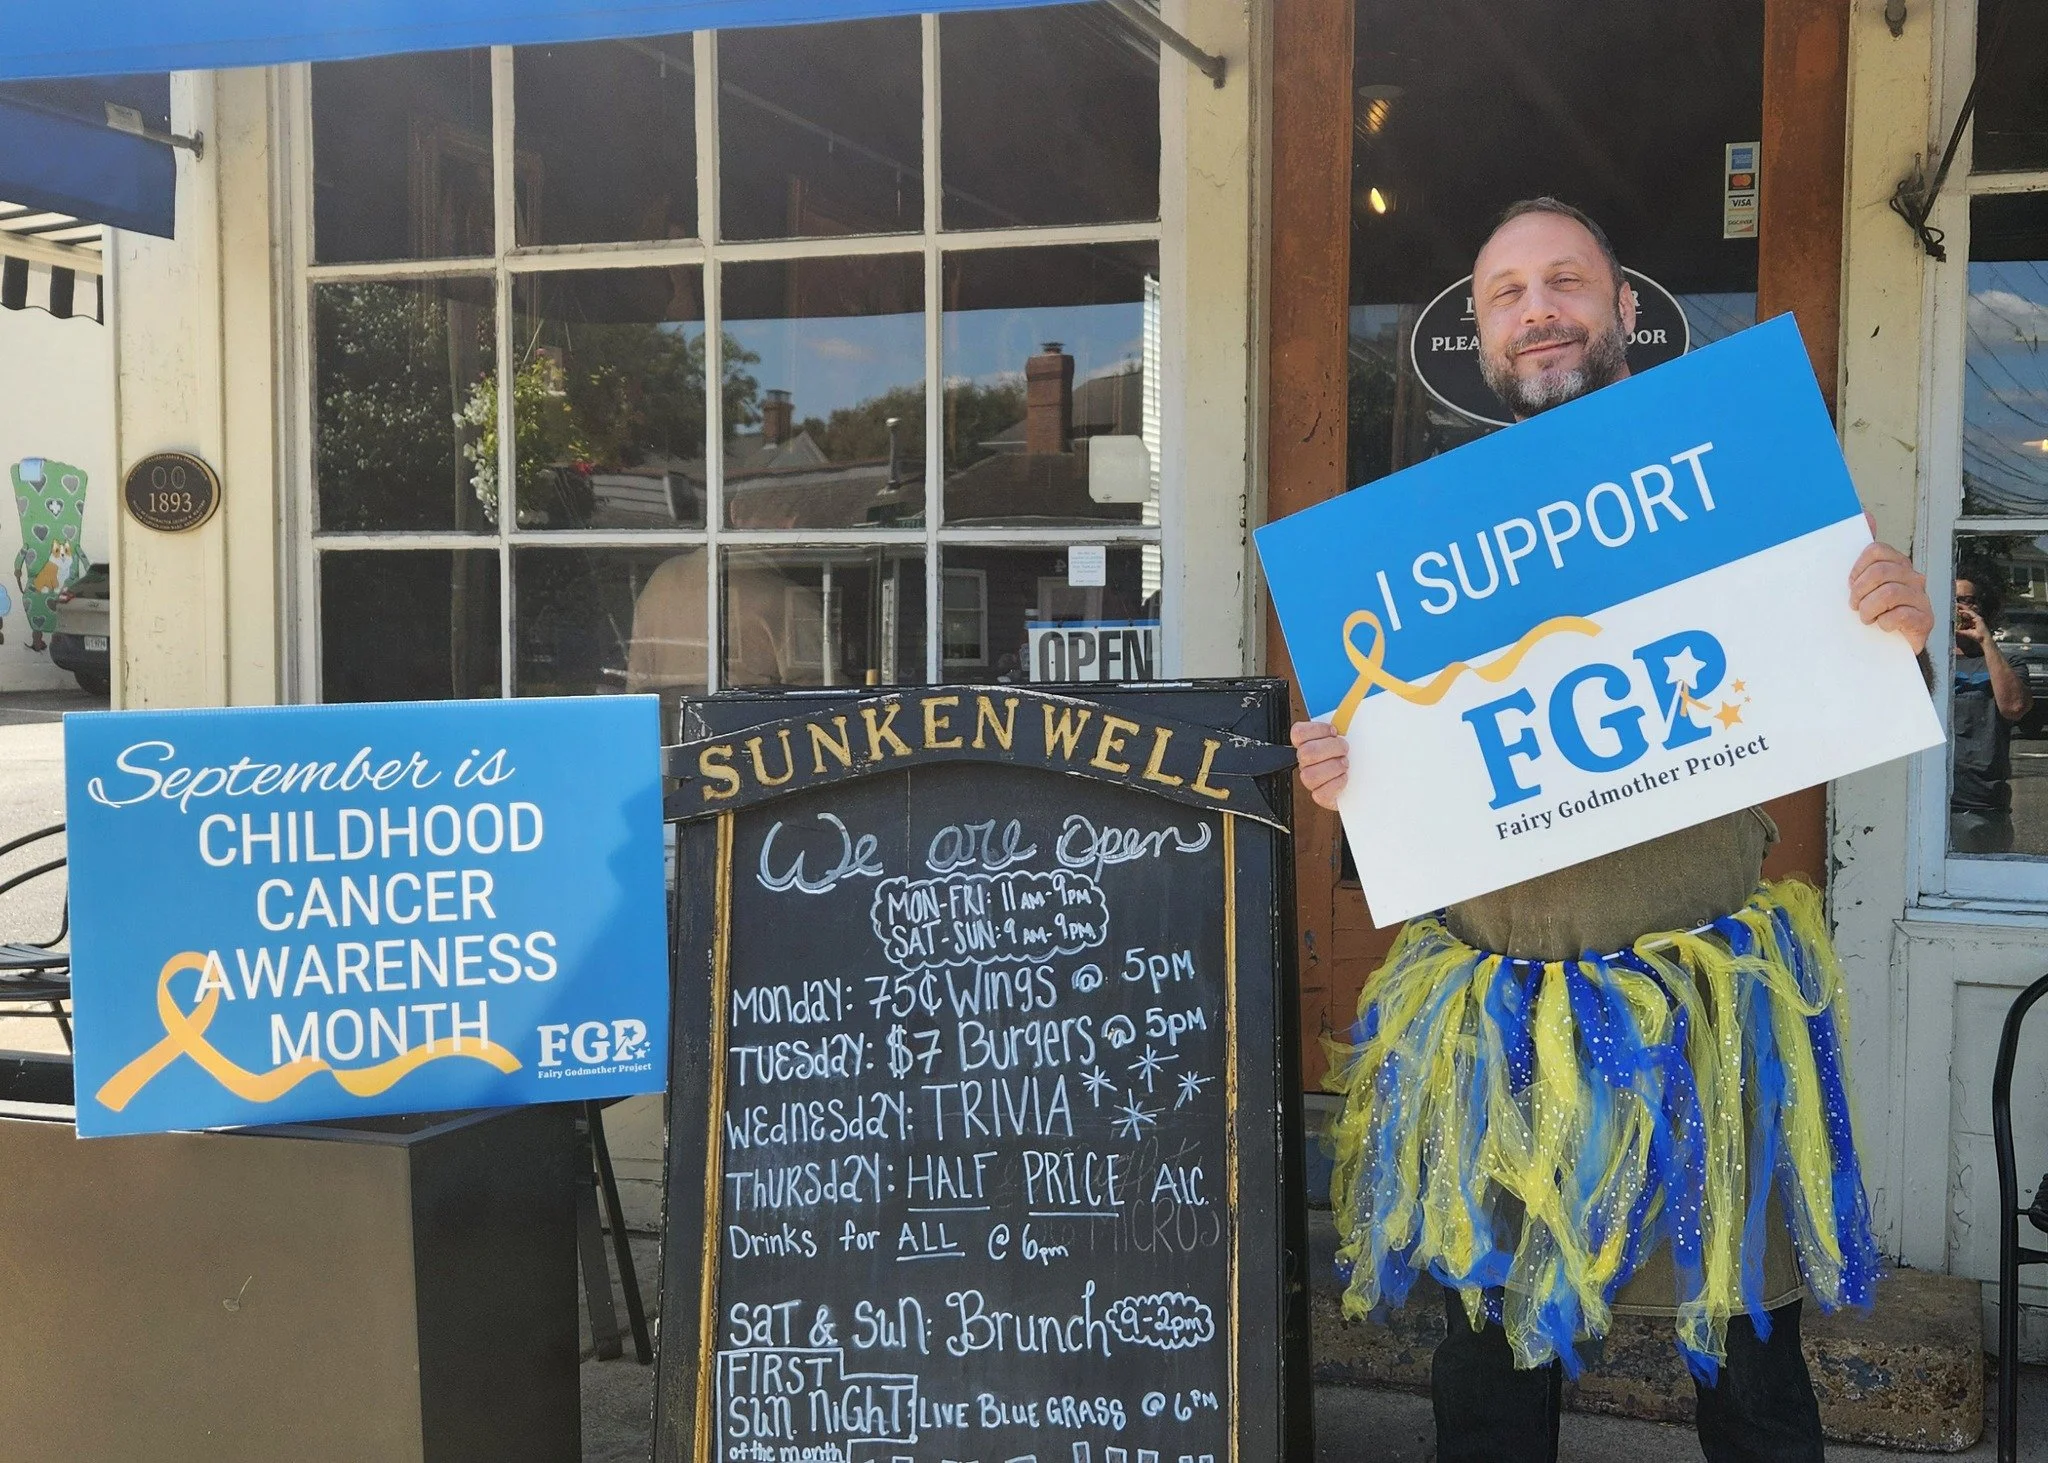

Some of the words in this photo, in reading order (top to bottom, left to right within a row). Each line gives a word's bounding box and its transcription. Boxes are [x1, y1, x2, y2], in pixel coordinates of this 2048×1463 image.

[1732, 199, 1752, 207] VISA
[1431, 335, 1480, 351] PLEA
[1627, 329, 1668, 344] OOR
[148, 492, 192, 513] 1893
[1375, 570, 1403, 632] I
[1412, 441, 1716, 615] SUPPORT
[1038, 629, 1153, 682] OPEN
[699, 696, 1018, 802] SUNKEN
[1043, 704, 1231, 800] WELL
[1461, 628, 1728, 811] FGP
[87, 741, 441, 813] September
[454, 747, 515, 787] is
[1495, 810, 1552, 841] Fairy
[1558, 766, 1680, 819] Godmother
[1685, 734, 1770, 776] Project
[200, 802, 543, 867] CHILDHOOD
[756, 812, 884, 893] We
[926, 818, 1037, 872] are
[1056, 814, 1211, 883] Open
[257, 869, 497, 931] CANCER
[194, 931, 557, 1004] AWARENESS
[864, 970, 942, 1019] 75¢
[945, 963, 1057, 1018] Wings
[1071, 963, 1103, 993] @
[270, 1001, 489, 1066] MONTH
[537, 1019, 647, 1067] FGP
[886, 1024, 943, 1080] $7
[958, 1015, 1096, 1072] Burgers
[1101, 1014, 1136, 1049] @
[538, 1069, 562, 1079] Fairy
[565, 1065, 617, 1077] Godmother
[619, 1063, 651, 1073] Project
[921, 1074, 1073, 1141] TRIVIA
[907, 1151, 998, 1201] HALF
[1022, 1150, 1125, 1206] PRICE
[729, 1223, 817, 1259] Drinks
[839, 1219, 880, 1251] for
[898, 1221, 958, 1252] ALL
[988, 1224, 1010, 1260] @
[1022, 1223, 1069, 1266] 6pm
[809, 1305, 838, 1347] &
[946, 1279, 1111, 1357] Brunch
[728, 1352, 833, 1397] FIRST
[920, 1397, 969, 1428] LIVE
[1046, 1395, 1127, 1430] GRASS
[1141, 1391, 1166, 1417] @
[729, 1442, 749, 1460] of
[750, 1440, 776, 1462] the
[780, 1441, 844, 1463] month
